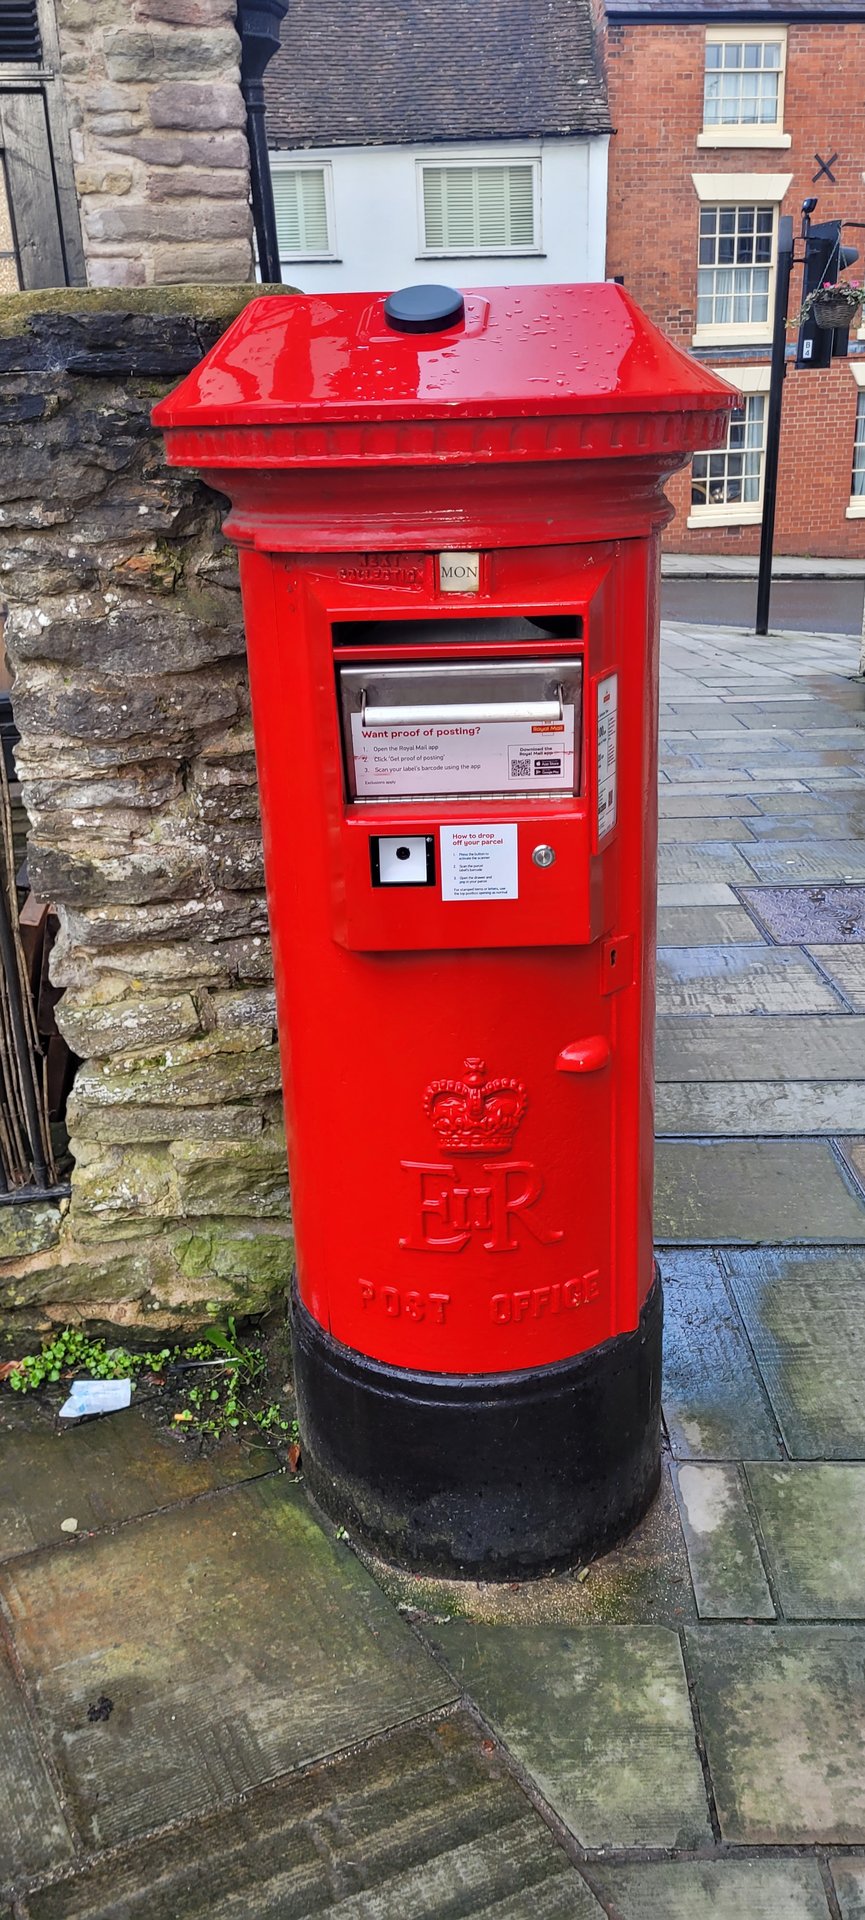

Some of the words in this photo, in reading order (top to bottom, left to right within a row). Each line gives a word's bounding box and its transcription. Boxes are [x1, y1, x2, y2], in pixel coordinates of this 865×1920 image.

[359, 554, 400, 567] NEXT
[441, 566, 478, 578] MON
[362, 730, 388, 739] Want
[391, 728, 420, 739] proof
[423, 728, 434, 736] of
[436, 726, 480, 738] posting?
[358, 1278, 449, 1325] POST
[491, 1268, 600, 1325] OFFICE
